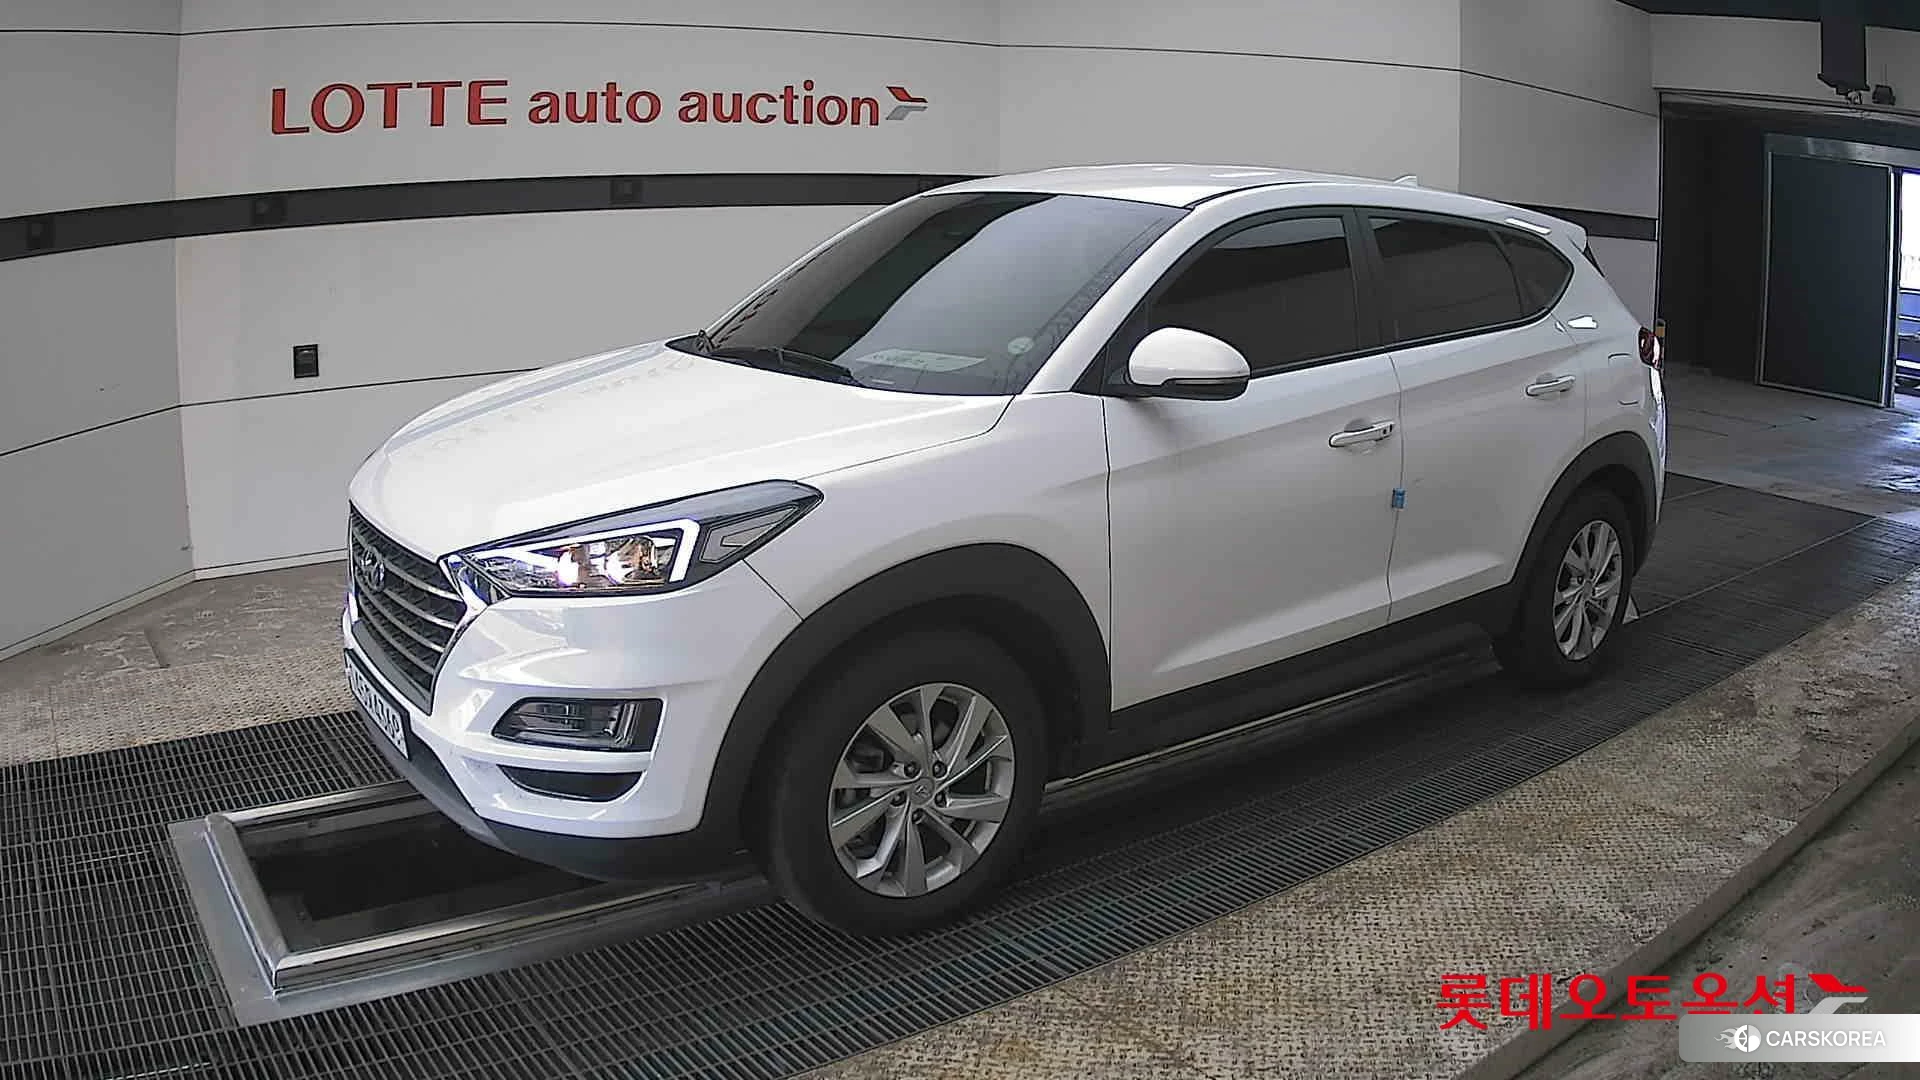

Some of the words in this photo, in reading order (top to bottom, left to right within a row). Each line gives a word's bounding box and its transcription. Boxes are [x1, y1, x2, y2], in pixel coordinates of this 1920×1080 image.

[271, 80, 508, 134] LOTTE
[528, 81, 662, 125] auto
[677, 80, 880, 126] auction
